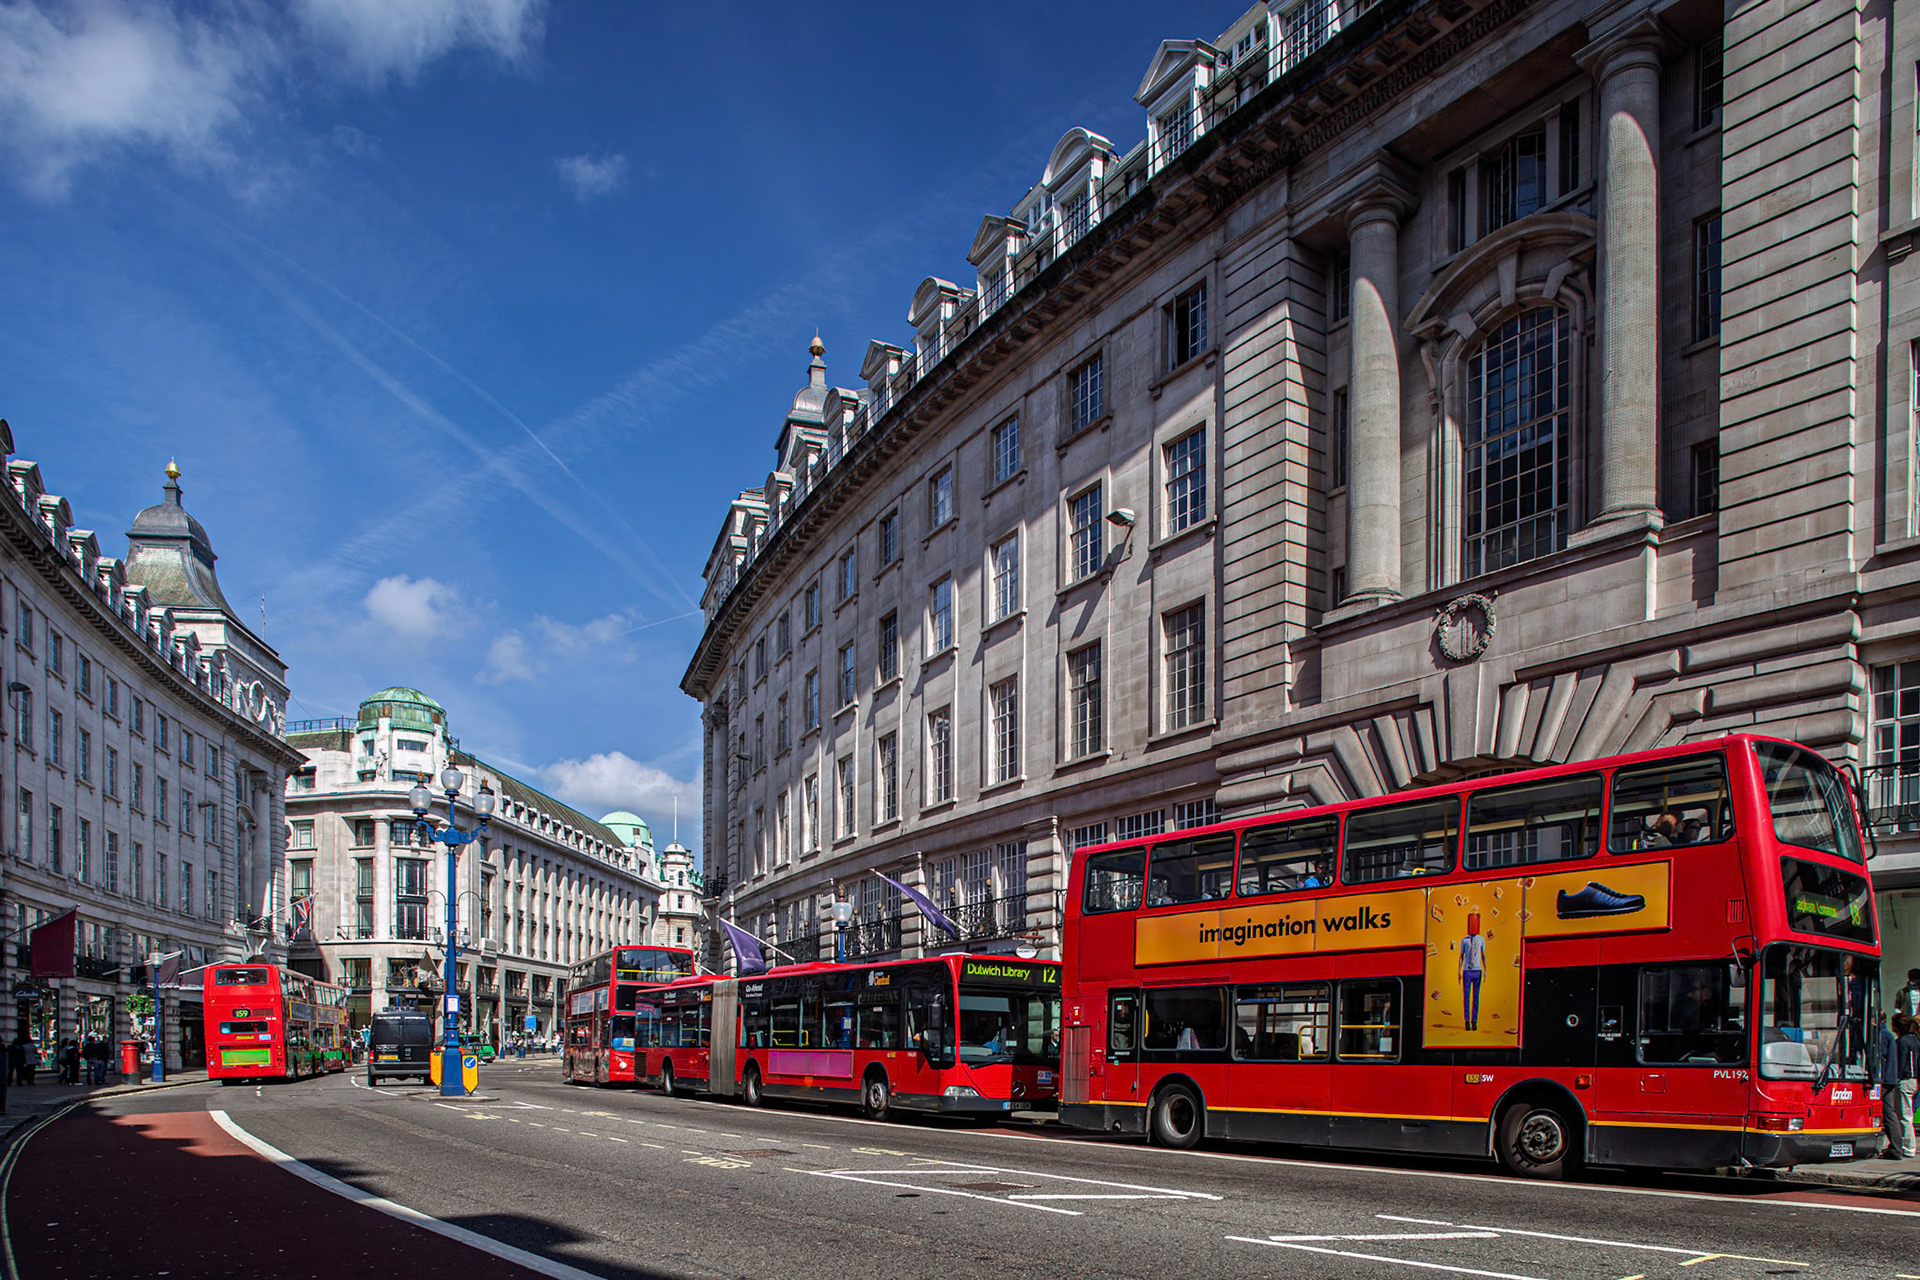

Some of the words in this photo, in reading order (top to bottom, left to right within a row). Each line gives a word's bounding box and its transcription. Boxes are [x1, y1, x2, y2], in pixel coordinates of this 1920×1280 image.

[1199, 915, 1316, 946] imagination
[1323, 906, 1391, 932] walks
[967, 963, 1000, 977] Dulwich
[1002, 965, 1030, 981] Library
[1043, 966, 1056, 983] 12
[235, 1009, 249, 1018] 159
[1482, 1074, 1494, 1082] SW
[1713, 1070, 1749, 1080] PVL192
[1831, 1087, 1852, 1100] London
